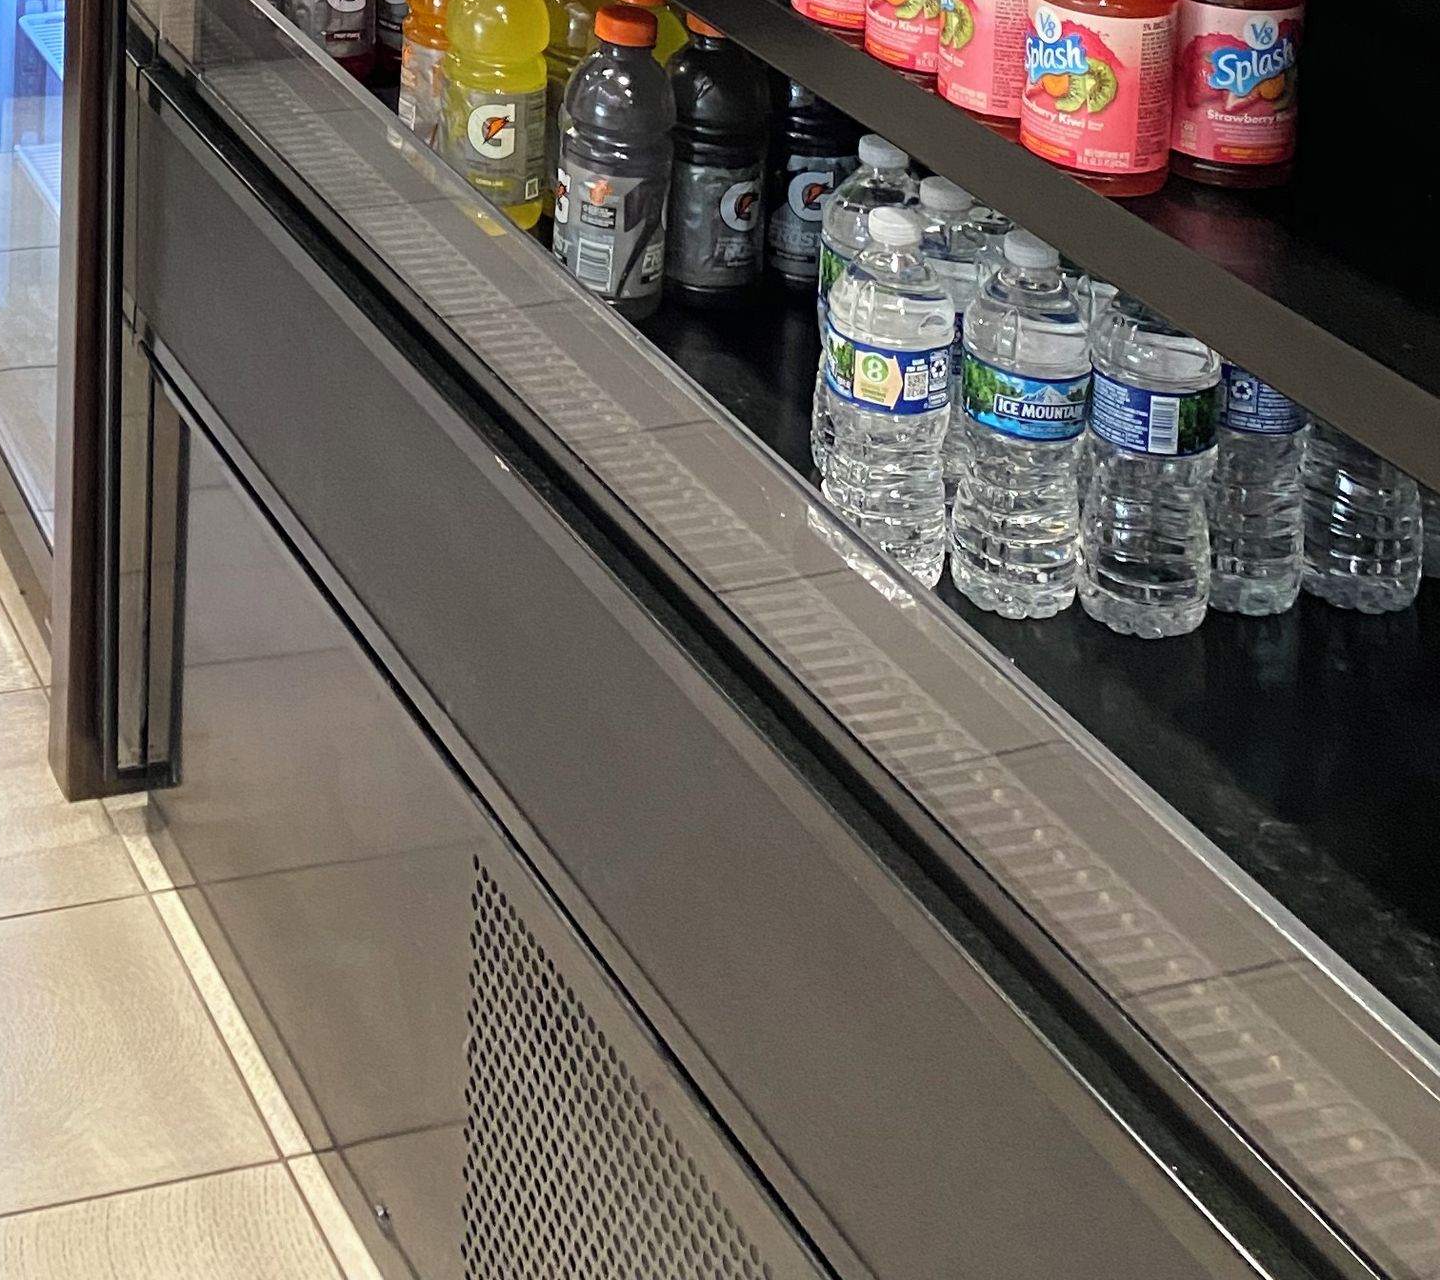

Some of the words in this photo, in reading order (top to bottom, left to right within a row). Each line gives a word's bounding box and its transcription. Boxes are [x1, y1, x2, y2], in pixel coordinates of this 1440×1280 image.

[899, 20, 923, 33] Kiwi
[1038, 11, 1056, 40] V8
[1251, 23, 1273, 45] V8
[1216, 40, 1295, 87] Splash
[1059, 113, 1085, 130] Kiwi
[1207, 108, 1275, 127] Strawberry
[467, 103, 515, 159] G
[788, 171, 834, 222] G
[997, 398, 1020, 415] ICE
